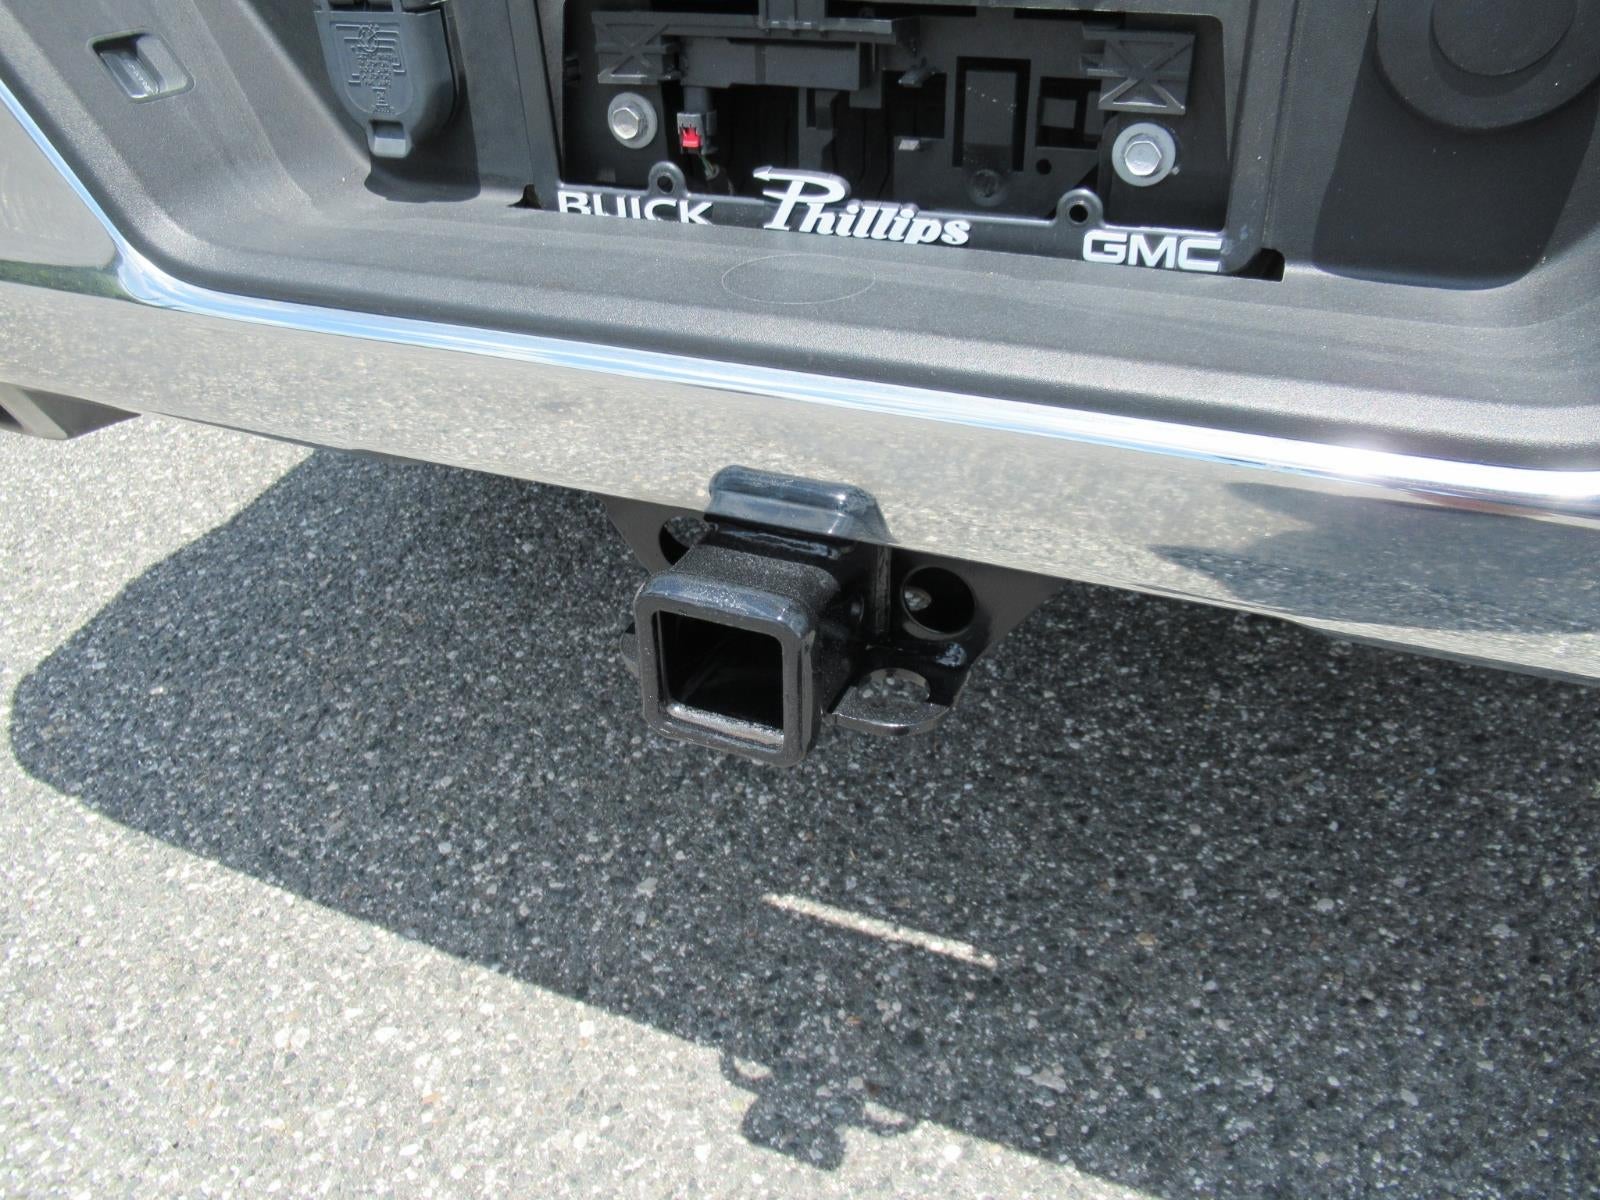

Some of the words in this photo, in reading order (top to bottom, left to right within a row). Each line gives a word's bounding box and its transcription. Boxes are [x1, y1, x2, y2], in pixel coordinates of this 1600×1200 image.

[557, 190, 713, 225] BUICK
[752, 166, 971, 245] Phillips
[1083, 230, 1222, 273] GMC
